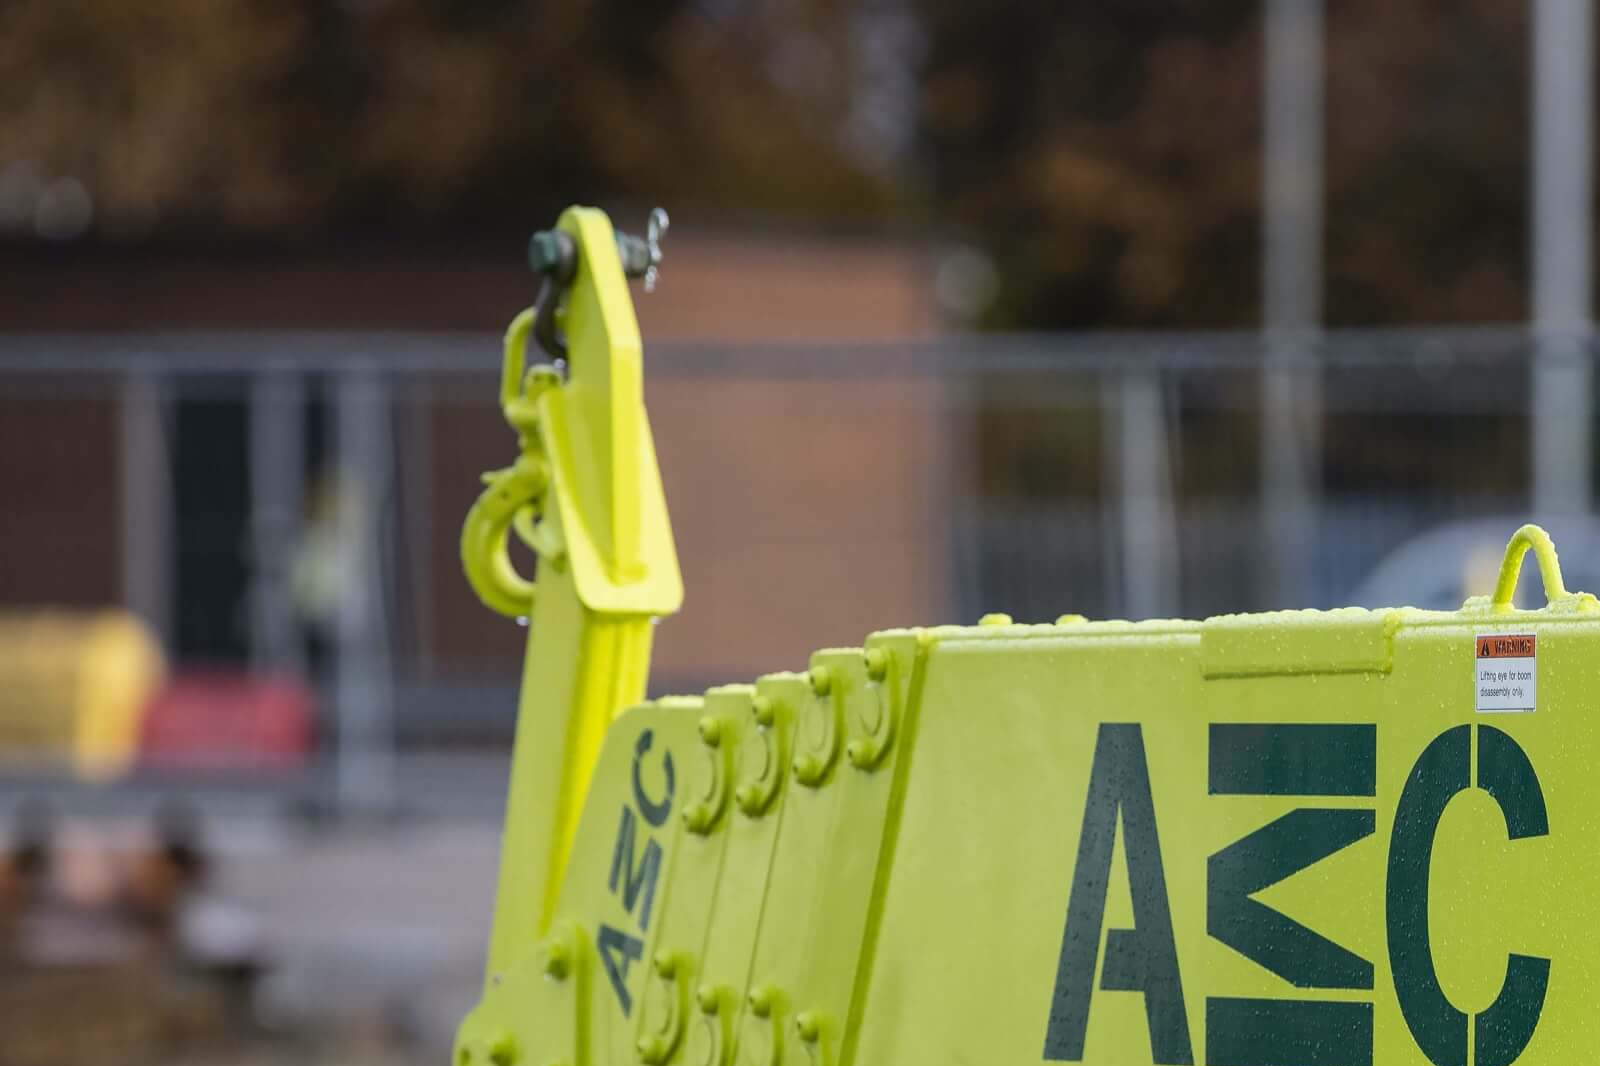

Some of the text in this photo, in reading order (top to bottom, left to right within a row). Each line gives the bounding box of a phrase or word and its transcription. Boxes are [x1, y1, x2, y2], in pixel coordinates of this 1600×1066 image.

[1494, 639, 1532, 654] WARNING
[1480, 671, 1497, 683] Lifting
[1498, 673, 1508, 683] eye
[1509, 670, 1517, 681] for
